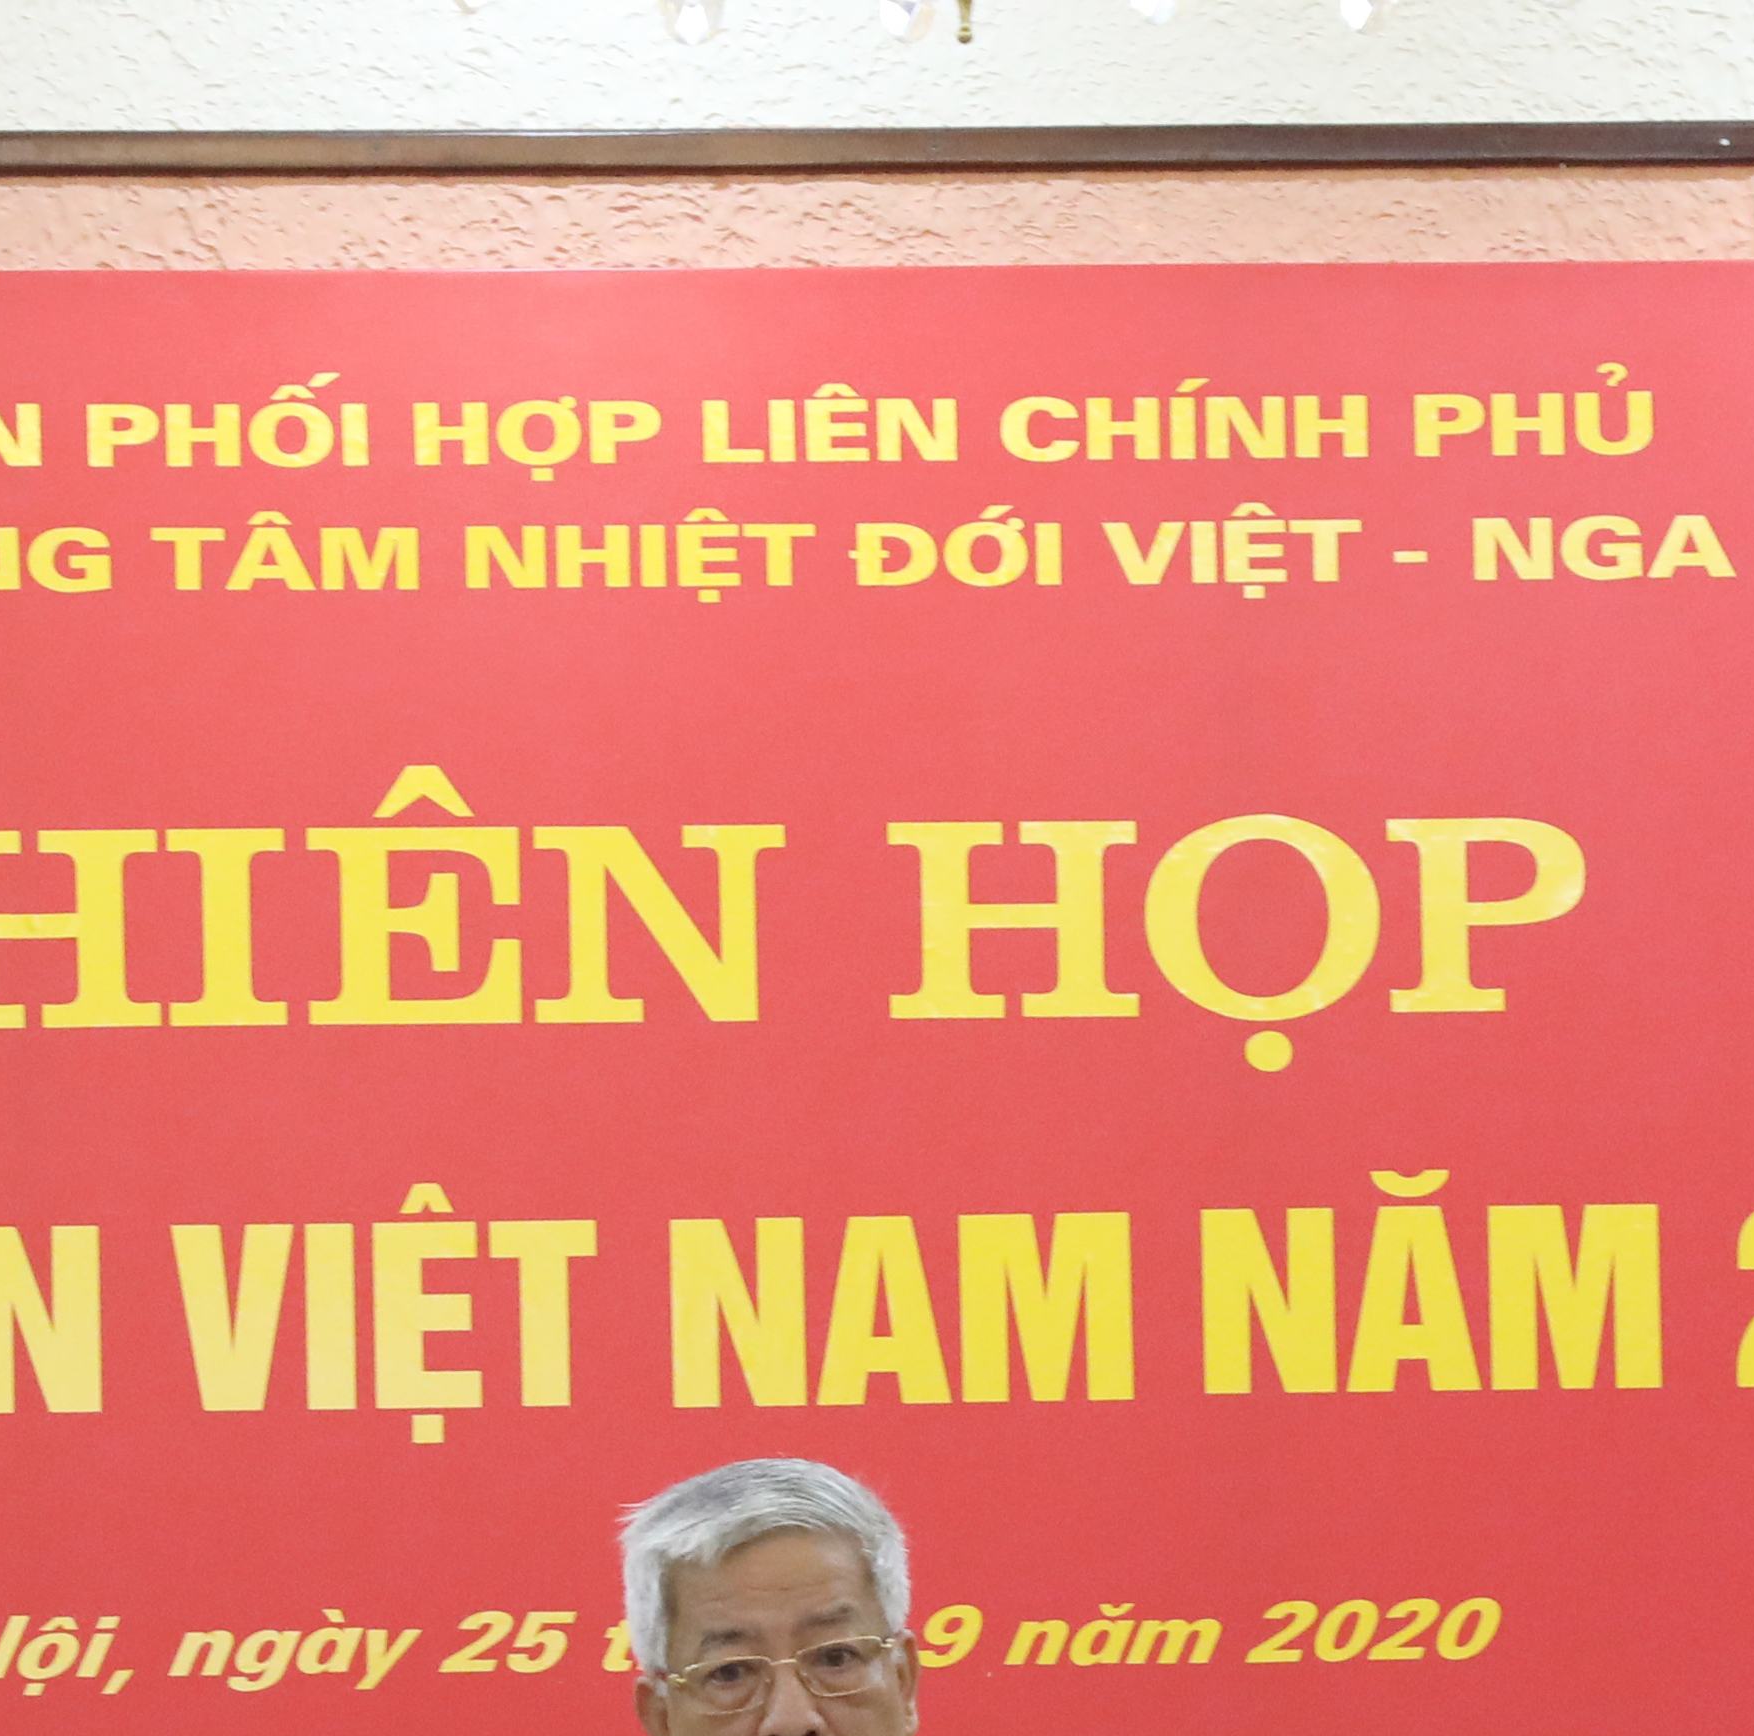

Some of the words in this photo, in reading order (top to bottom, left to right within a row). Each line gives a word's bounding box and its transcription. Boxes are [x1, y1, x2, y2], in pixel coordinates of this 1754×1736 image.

[86, 372, 370, 469] PHỐI
[412, 396, 662, 482] HỢP
[702, 383, 960, 464] LIÊN
[1000, 377, 1370, 463] CHÍNH
[1413, 362, 1655, 458] PHỦ
[149, 510, 421, 592] TÂM
[464, 507, 818, 604] NHIỆT
[848, 505, 1063, 588] ĐỚI
[1102, 502, 1363, 600] VIỆT
[1395, 550, 1428, 564] -
[1473, 515, 1737, 582] NGA
[885, 813, 1587, 1073] HỌP
[170, 1182, 599, 1445] VIỆT
[669, 1211, 1136, 1409] NAM
[1199, 1169, 1664, 1395] NĂM
[170, 1608, 421, 1693] ngày
[438, 1609, 578, 1674] 25
[917, 1604, 984, 1669] 9
[1004, 1602, 1223, 1667] năm
[1244, 1597, 1502, 1664] 2020
